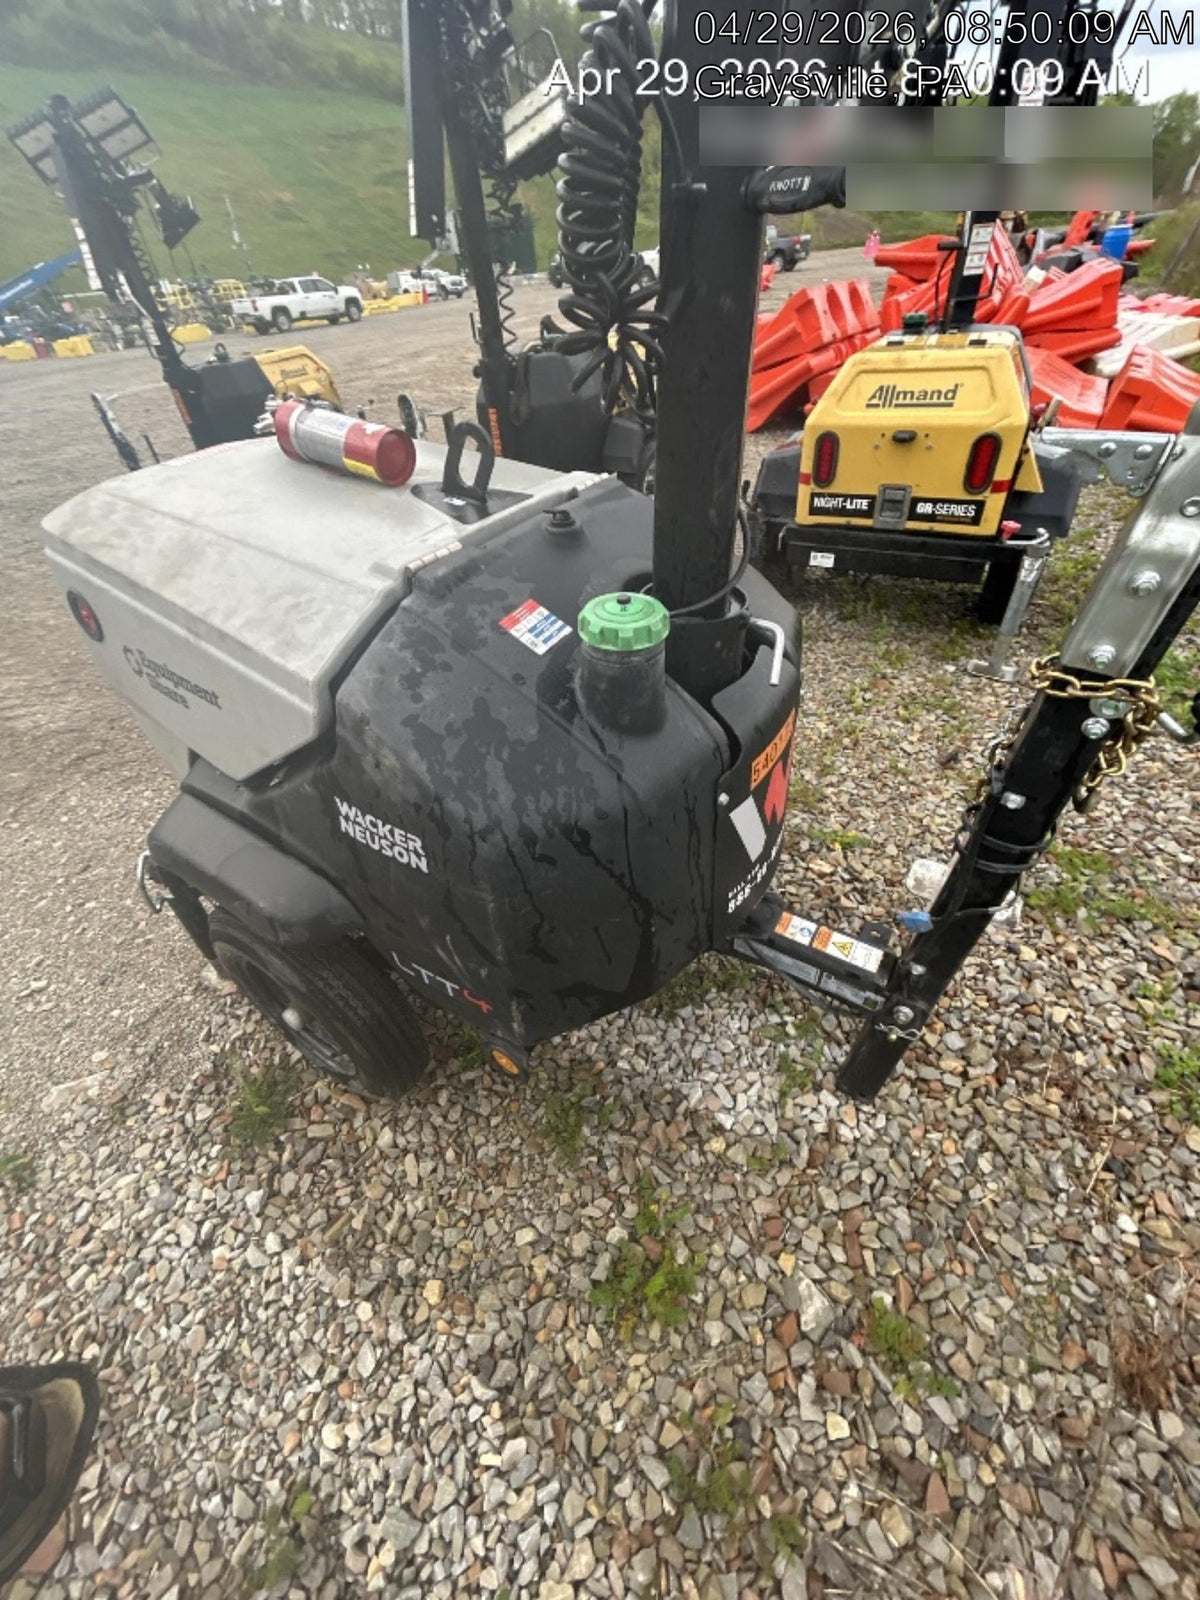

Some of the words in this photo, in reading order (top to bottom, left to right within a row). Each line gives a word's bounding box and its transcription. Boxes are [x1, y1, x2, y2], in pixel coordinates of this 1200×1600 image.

[866, 383, 960, 408] Allmand
[813, 496, 871, 510] NIGHT-LITE
[916, 501, 977, 517] GR-SERIES
[334, 796, 425, 856] WACKER
[339, 816, 429, 874] NEUSON
